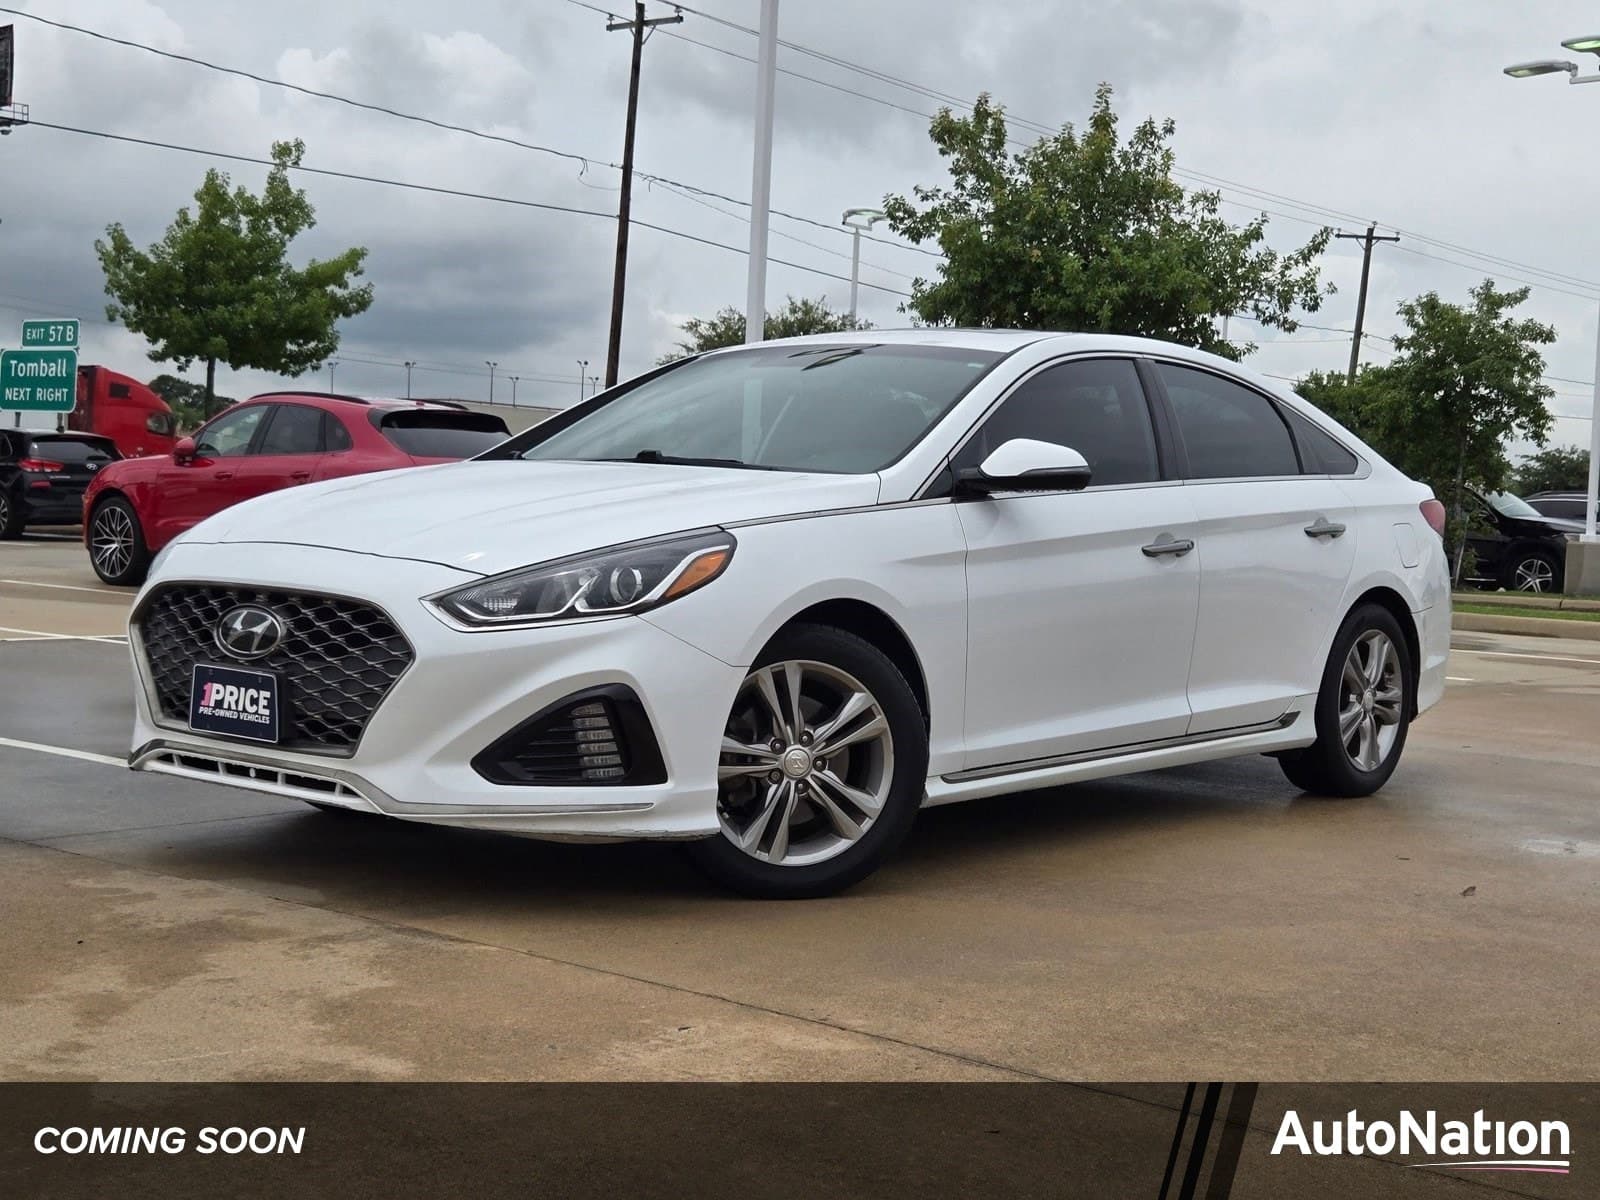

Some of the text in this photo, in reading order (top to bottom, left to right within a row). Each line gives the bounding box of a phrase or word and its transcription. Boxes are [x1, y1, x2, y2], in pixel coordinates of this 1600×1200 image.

[26, 328, 45, 340] EXIT
[10, 358, 67, 377] Tomball
[5, 388, 69, 401] NEXT RIGHT
[200, 682, 271, 715] 1PRICE
[198, 706, 270, 724] PRE-OWNED VEHICLES
